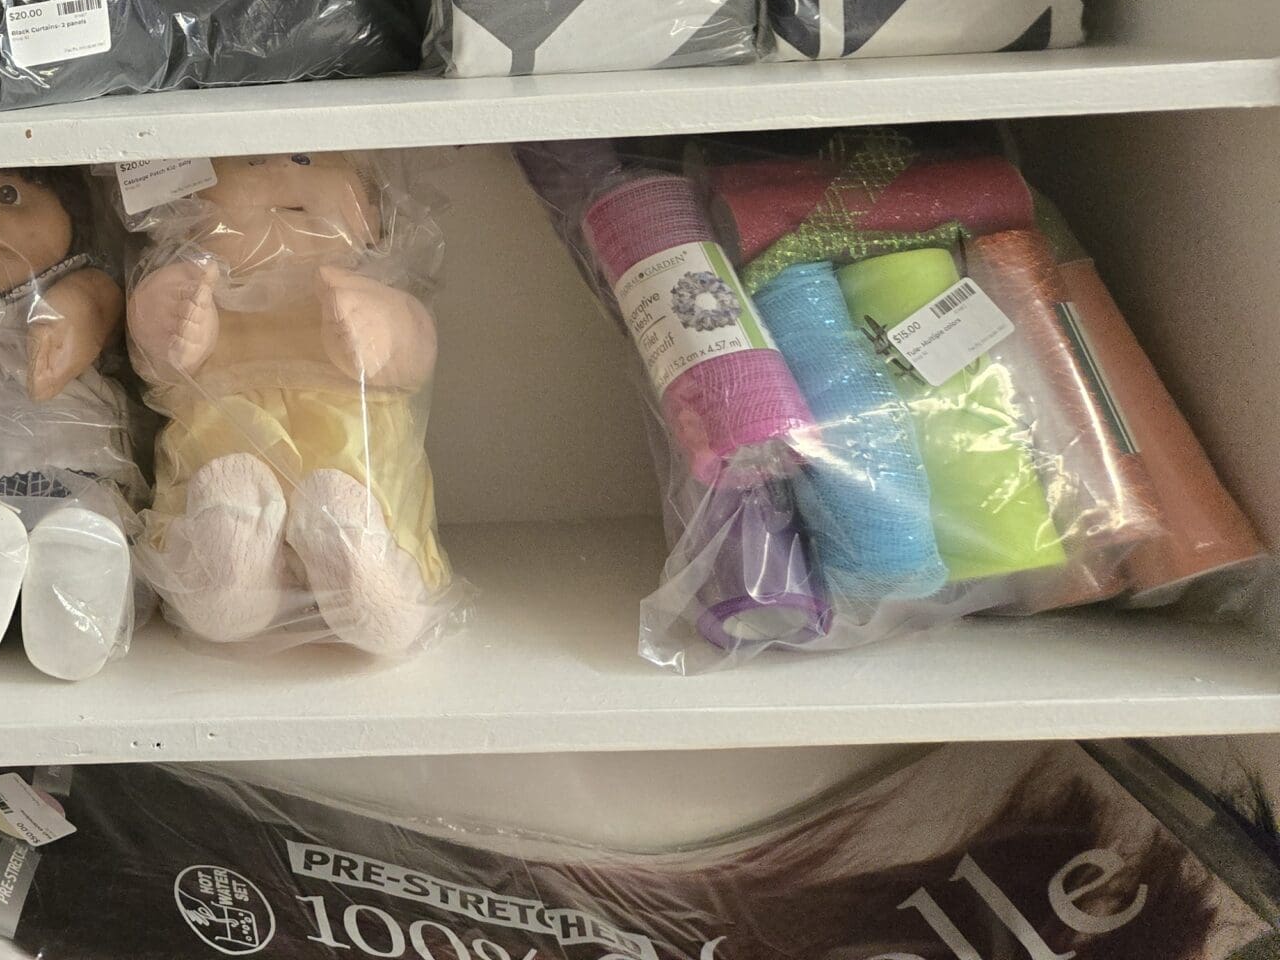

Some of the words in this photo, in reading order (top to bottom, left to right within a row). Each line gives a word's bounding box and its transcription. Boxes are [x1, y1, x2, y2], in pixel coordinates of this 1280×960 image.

[8, 8, 42, 21] $20.00
[11, 27, 29, 37] Black
[67, 19, 87, 28] panels
[120, 160, 151, 173] $20.00
[123, 174, 149, 186] Cabbage
[150, 169, 166, 177] Patch
[893, 321, 921, 344] $15.00
[921, 331, 945, 347] Multiple
[944, 318, 961, 331] colors
[707, 339, 726, 354] 4.57
[17, 822, 40, 844] $50.00
[197, 871, 213, 895] HOT
[213, 869, 233, 906] WATER
[232, 880, 249, 902] SET
[864, 848, 1149, 959] lle
